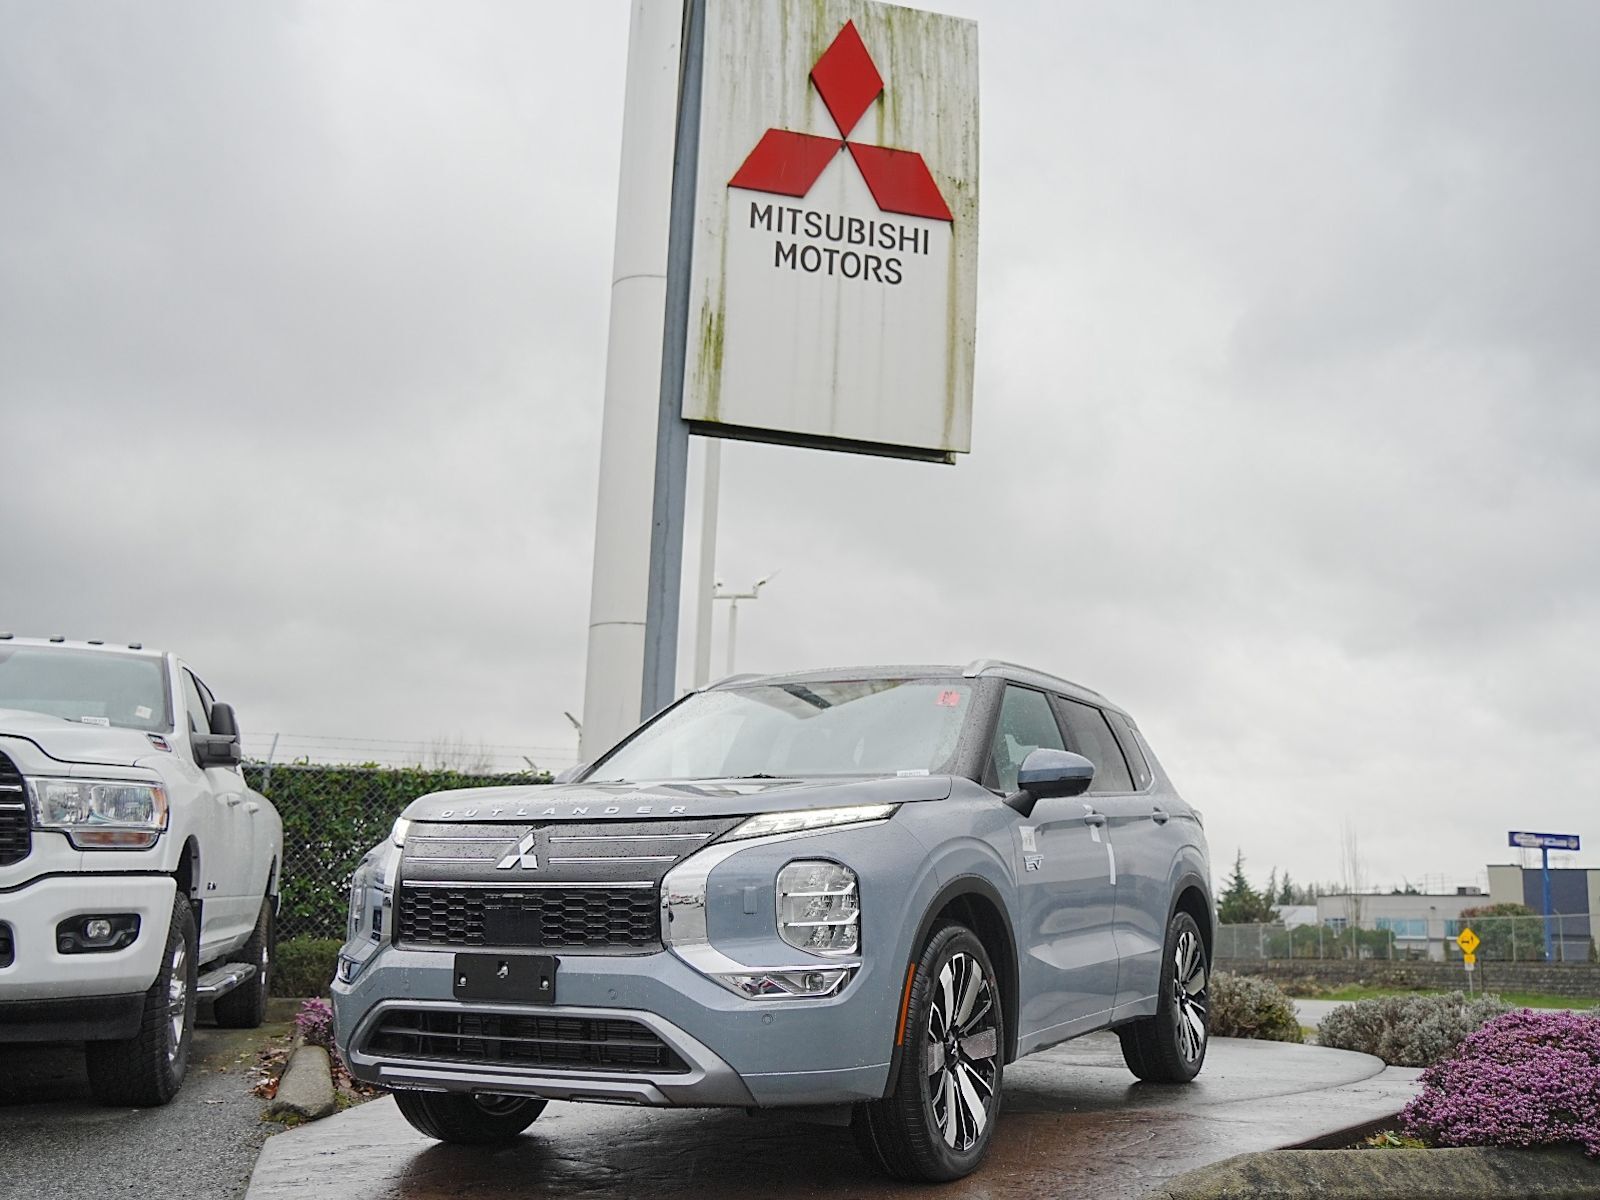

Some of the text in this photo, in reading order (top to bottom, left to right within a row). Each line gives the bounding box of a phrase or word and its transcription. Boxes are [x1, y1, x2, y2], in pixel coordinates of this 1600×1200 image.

[750, 202, 930, 255] MITSUBISHI
[774, 241, 903, 285] MOTORS
[440, 805, 688, 819] OUTLANDER
